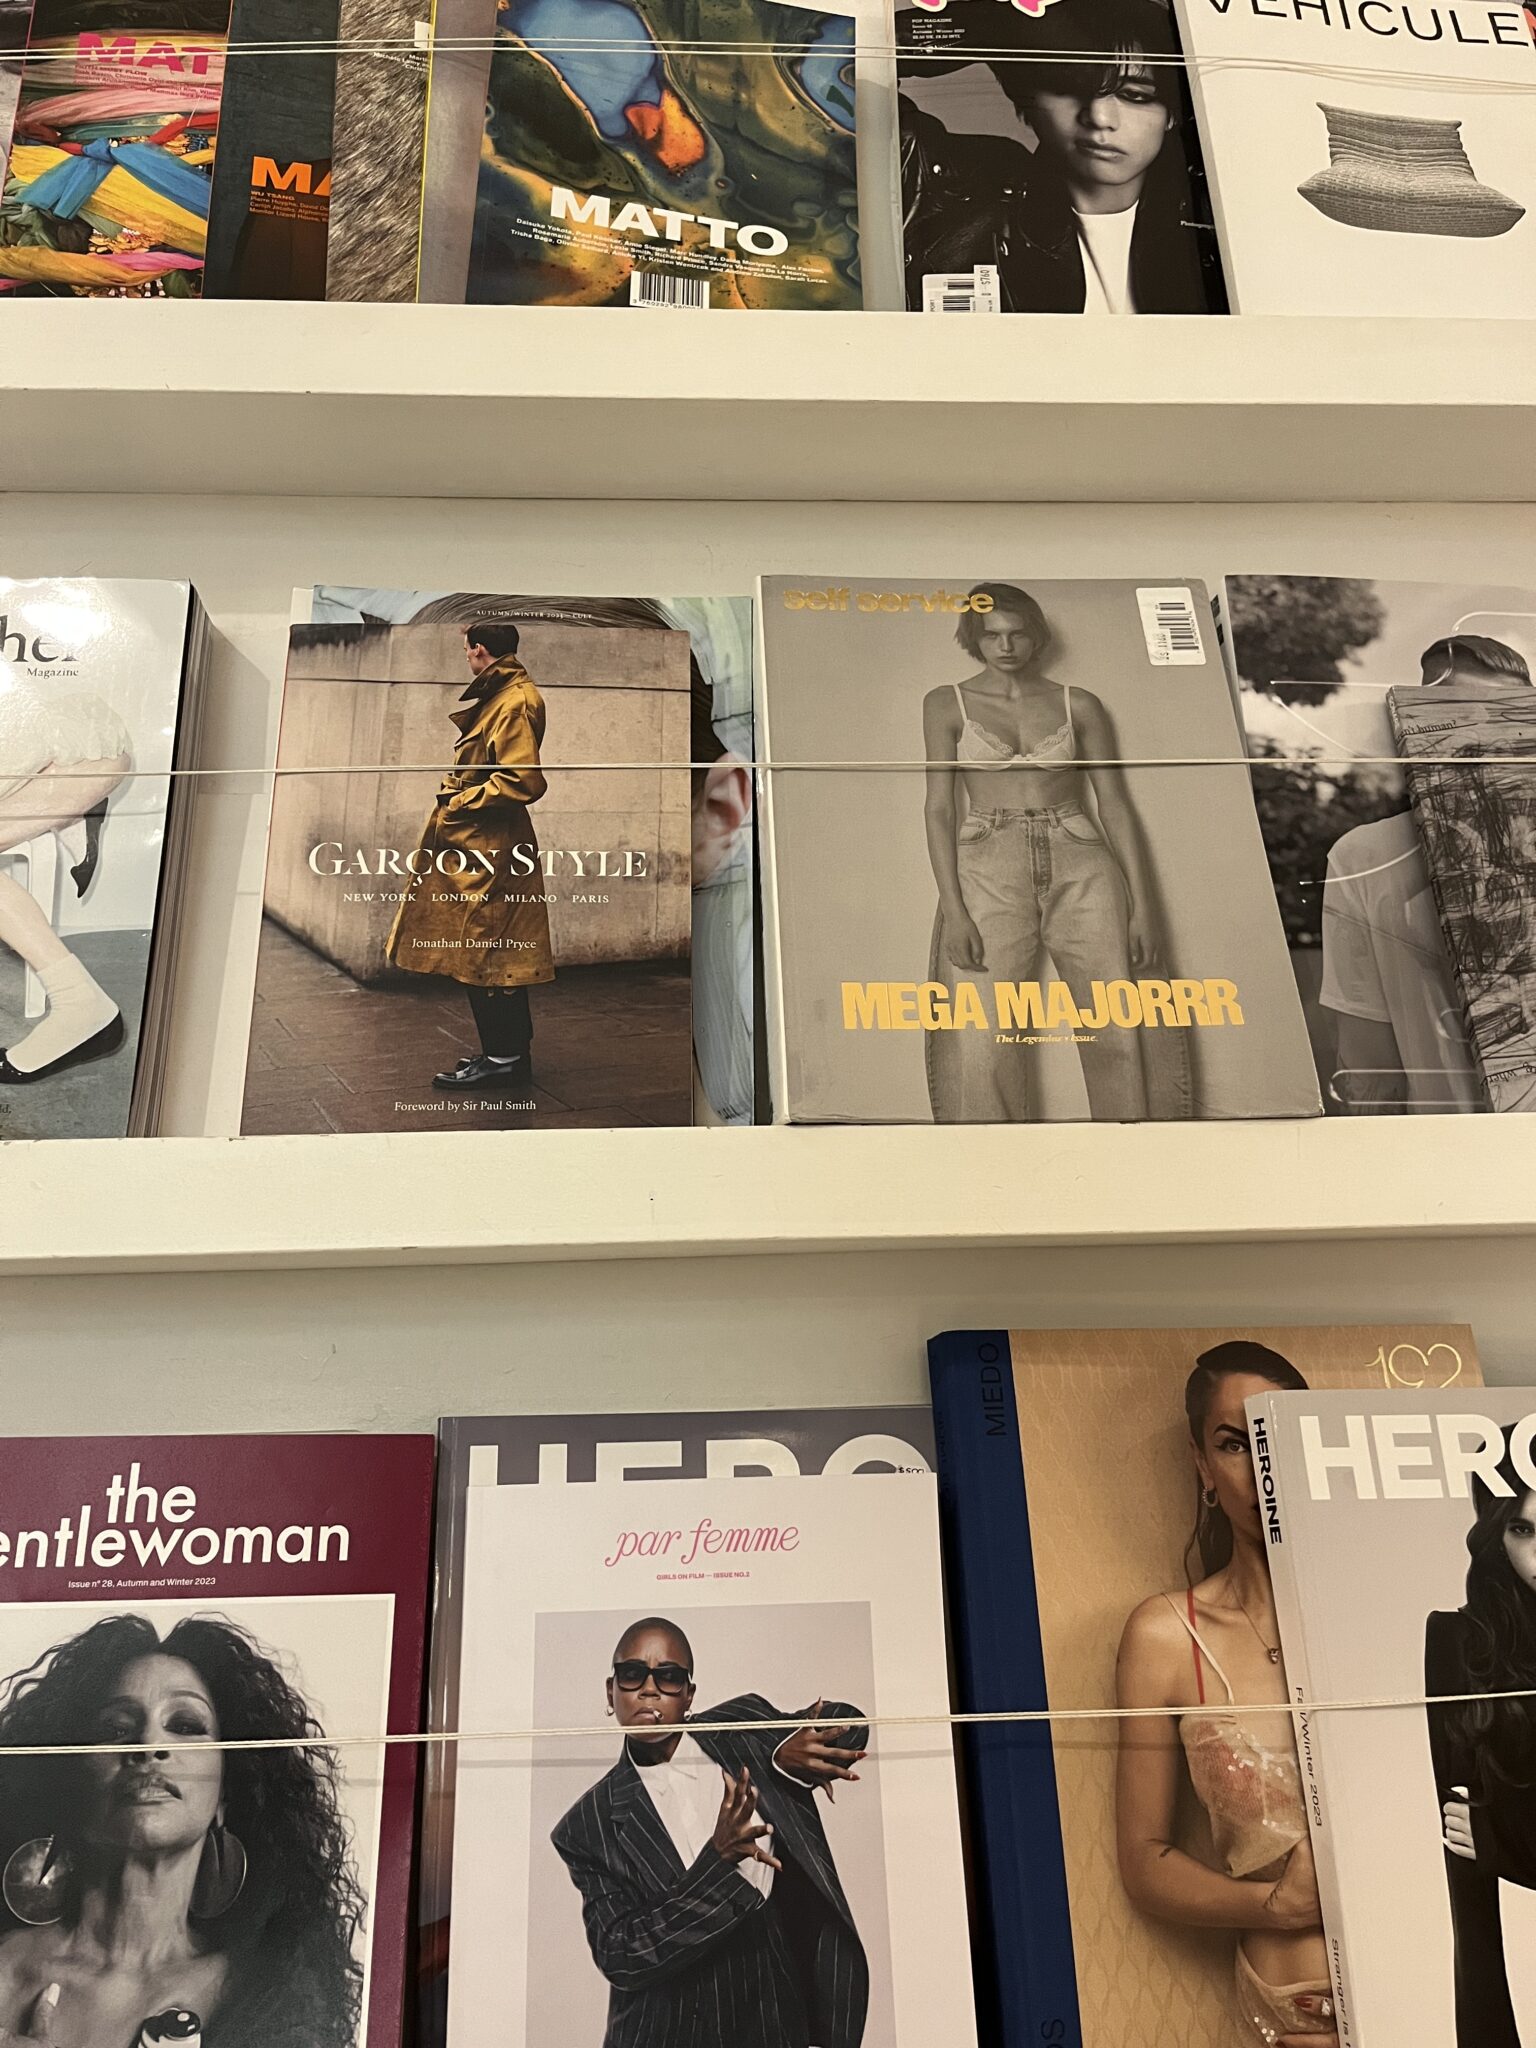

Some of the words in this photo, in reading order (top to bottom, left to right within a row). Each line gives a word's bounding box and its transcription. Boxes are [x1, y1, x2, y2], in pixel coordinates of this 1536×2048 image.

[511, 228, 533, 239] Trisha
[516, 218, 546, 229] Daisuke
[550, 185, 788, 256] MATTO
[532, 228, 571, 240] Rosemarie
[631, 247, 653, 256] Smith,
[654, 252, 682, 261] Richard
[783, 587, 850, 612] self
[855, 589, 994, 614] service
[27, 667, 79, 680] Magazine
[510, 842, 647, 880] STYLE
[343, 893, 374, 903] NEW
[380, 893, 417, 903] YORK
[431, 892, 489, 903] LONDON
[504, 893, 557, 904] MILANO
[572, 894, 610, 904] PARIS
[411, 937, 462, 949] Jonathan
[465, 937, 502, 949] Daniel
[506, 938, 537, 951] Pryce
[841, 980, 988, 1031] MEGA
[994, 978, 1245, 1030] MAJORRR
[995, 1034, 1014, 1043] The
[394, 1100, 445, 1111] Foreword
[447, 1100, 461, 1112] by
[462, 1100, 478, 1111] Sir
[480, 1100, 502, 1111] Paul
[505, 1099, 537, 1110] Smith
[978, 1342, 1007, 1438] MIEDO
[105, 1462, 197, 1524] the
[1253, 1416, 1283, 1545] HEROINE
[0, 1505, 350, 1569] ntlewoman
[603, 1527, 684, 1568] par
[680, 1518, 801, 1565] femme
[68, 1580, 91, 1588] Issue
[116, 1579, 149, 1588] Autumn
[149, 1579, 166, 1587] and
[167, 1578, 194, 1586] Winter
[194, 1577, 216, 1585] 2023
[1309, 1783, 1323, 1828] 2023
[1331, 1937, 1348, 2018] Stranger
